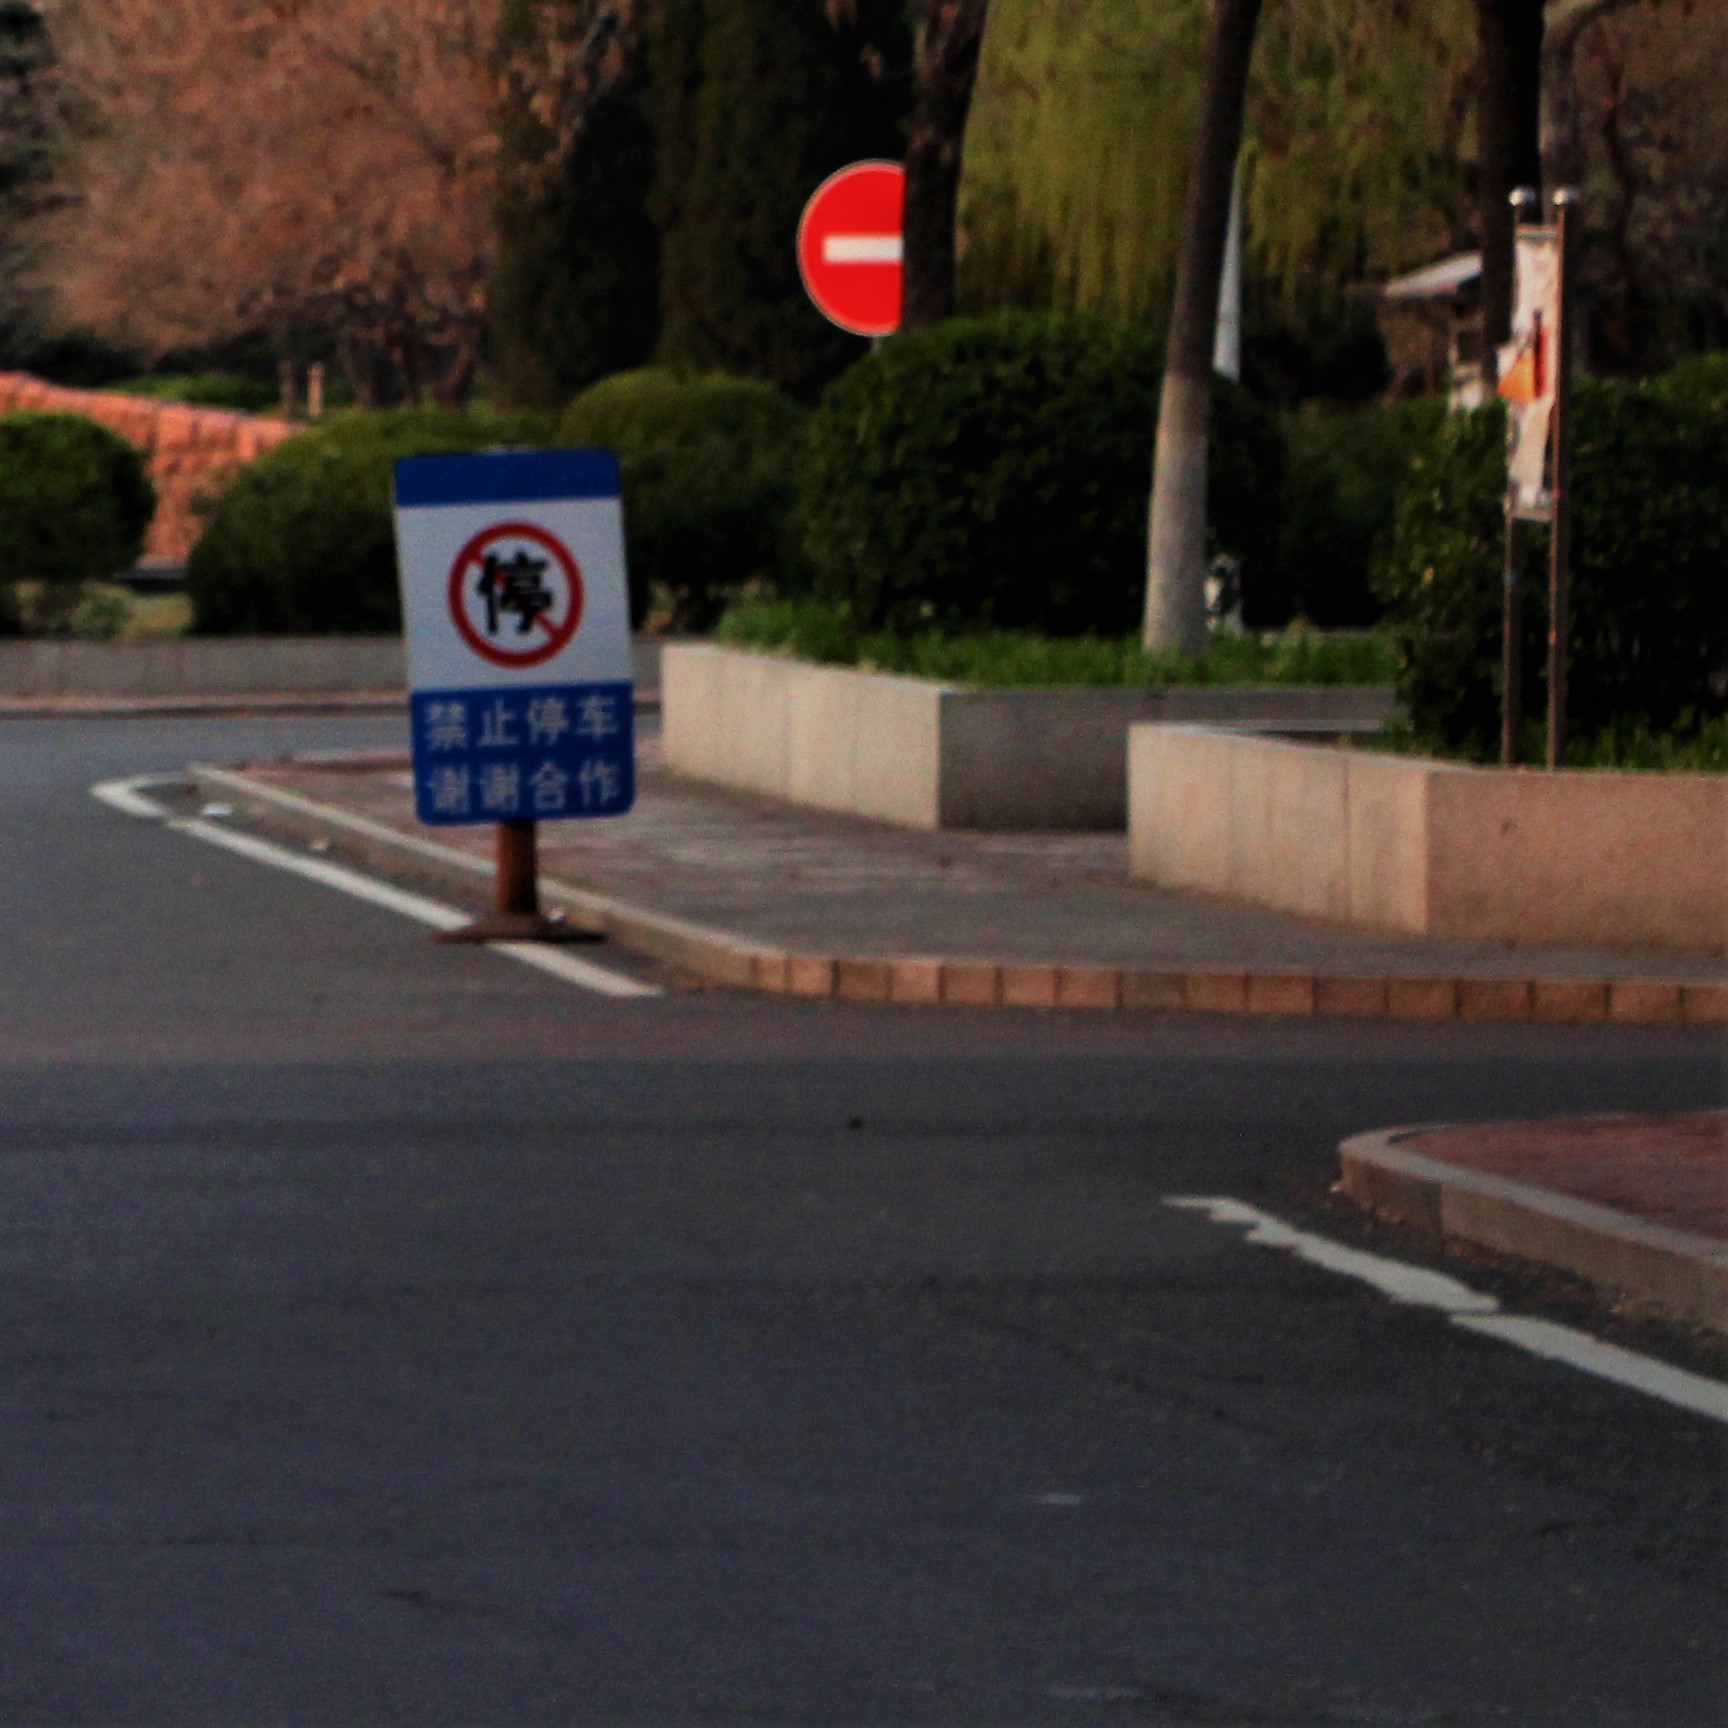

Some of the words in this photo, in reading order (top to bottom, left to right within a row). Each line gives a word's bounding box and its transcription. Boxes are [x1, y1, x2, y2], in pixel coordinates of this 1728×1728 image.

[478, 550, 553, 635] 停
[426, 695, 619, 750] 禁止停车
[426, 757, 621, 813] 谢谢合作
